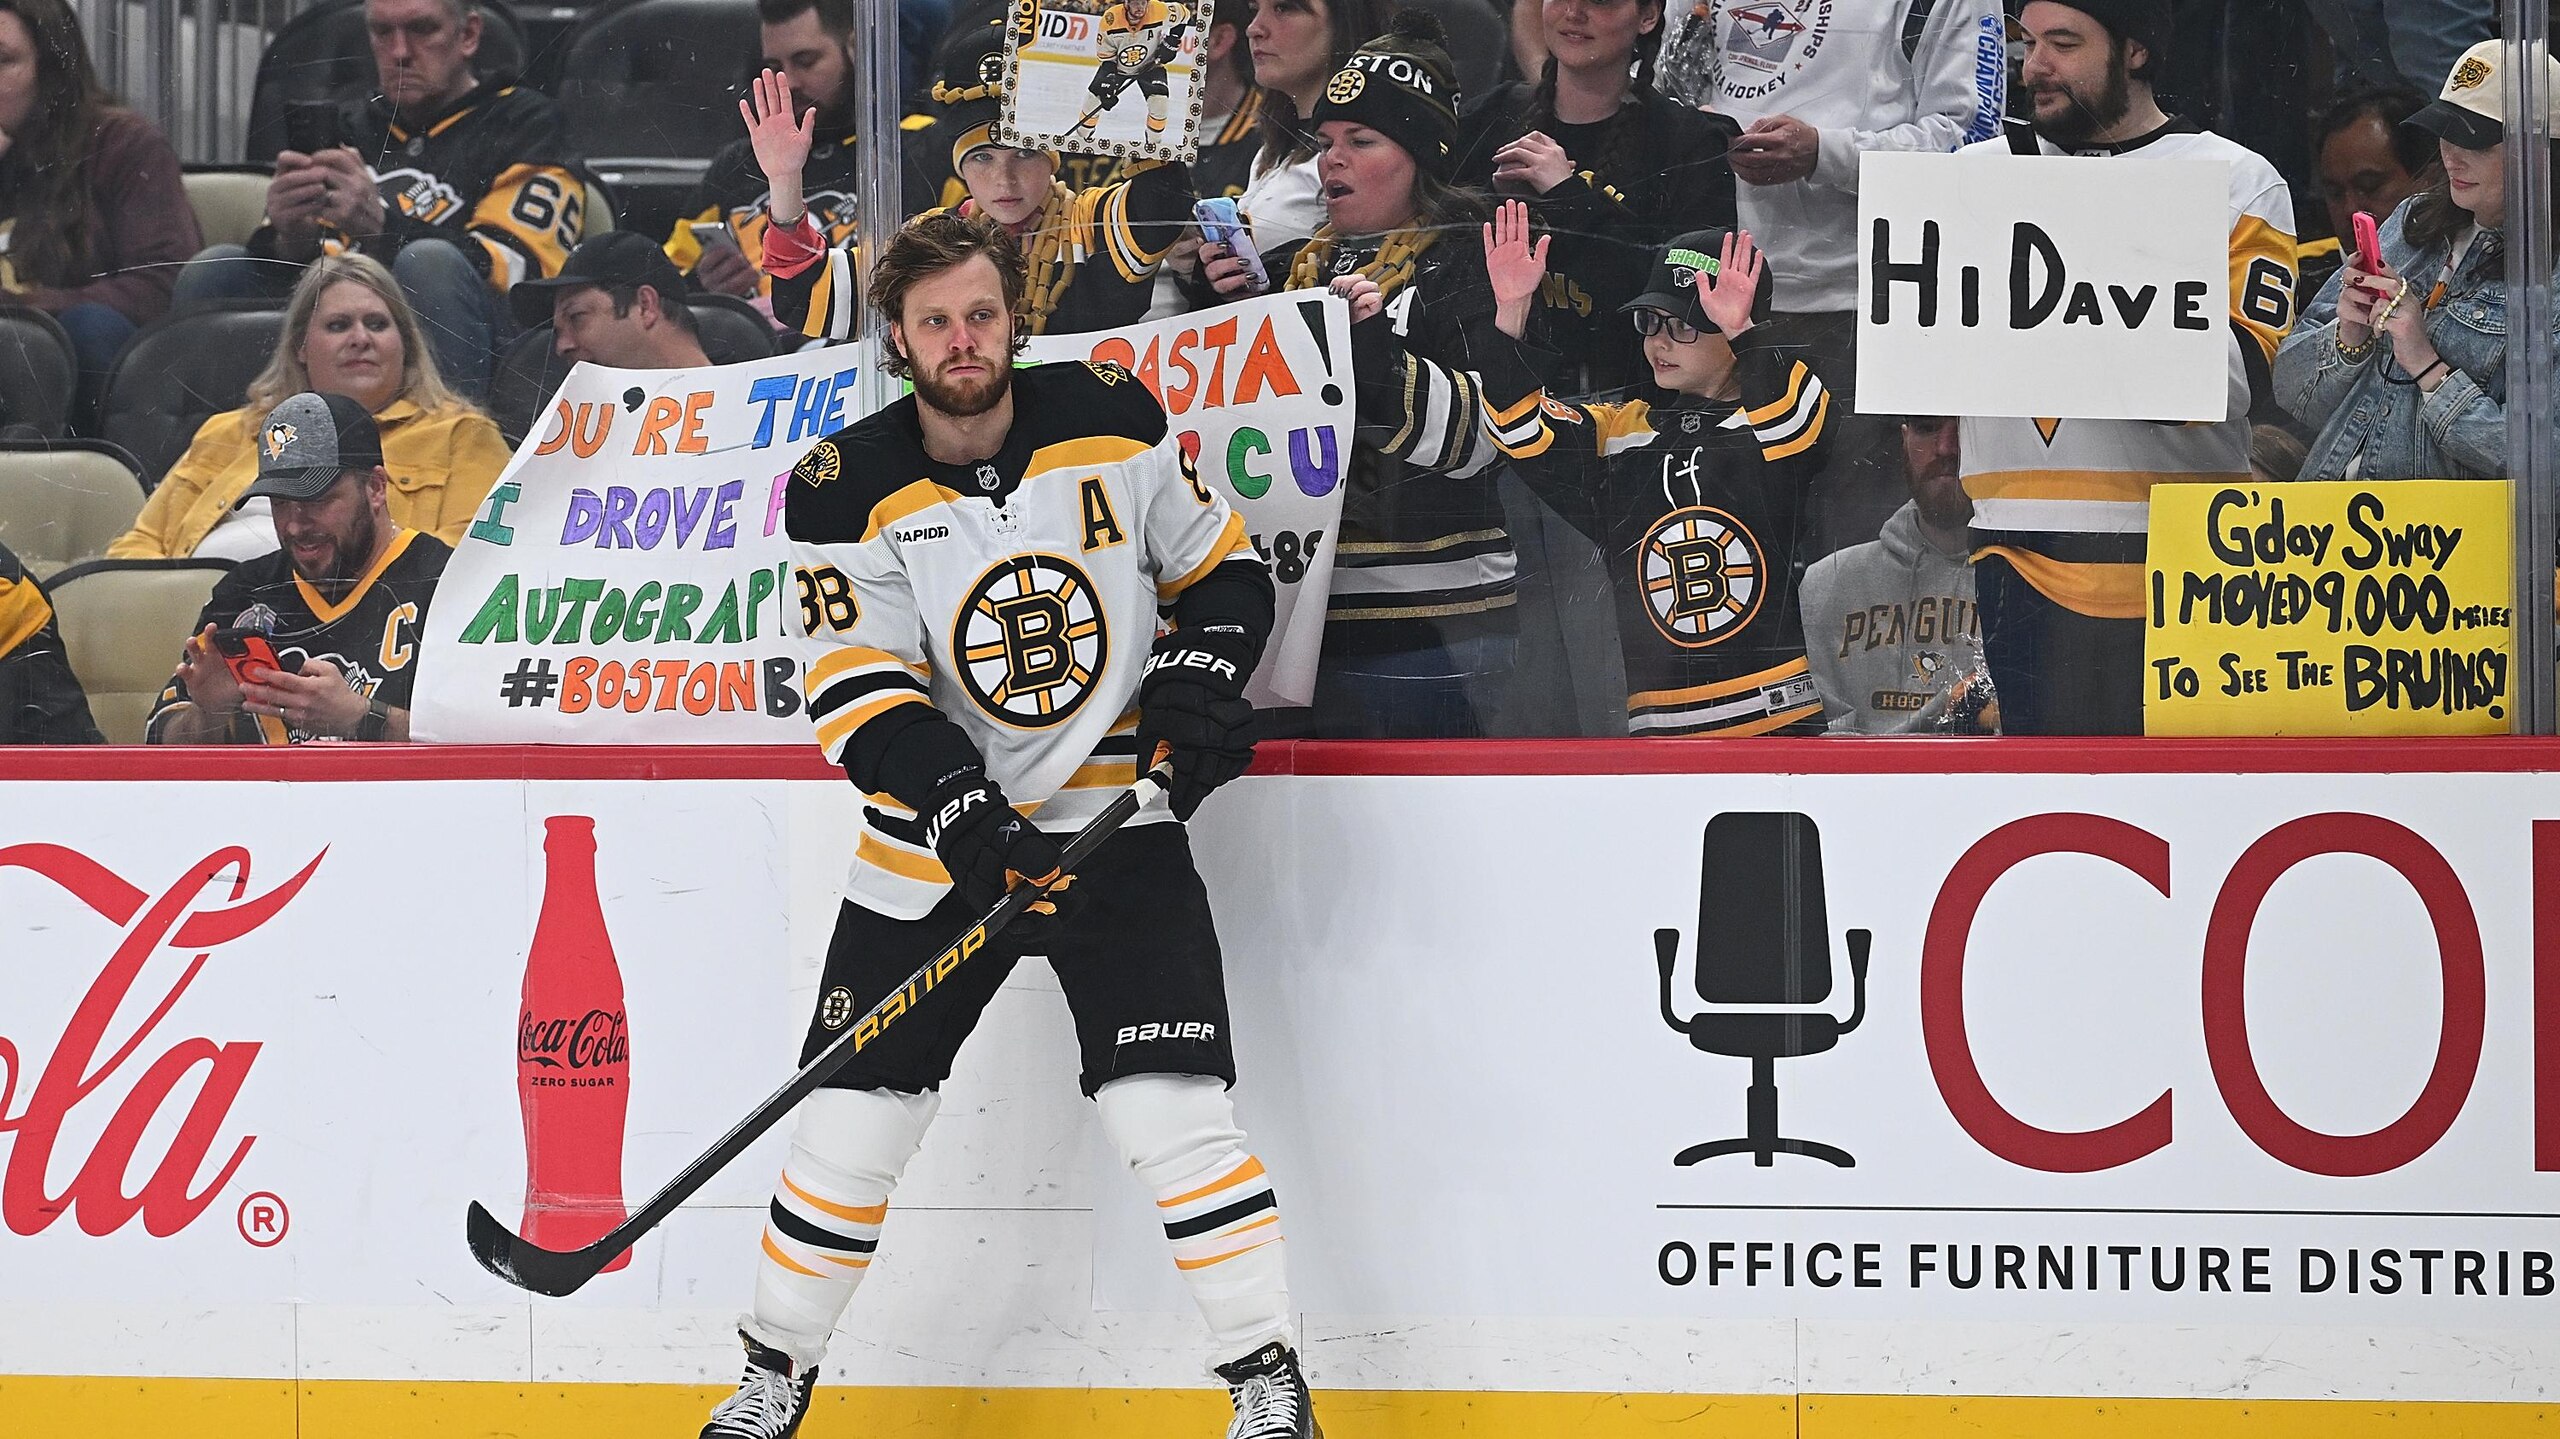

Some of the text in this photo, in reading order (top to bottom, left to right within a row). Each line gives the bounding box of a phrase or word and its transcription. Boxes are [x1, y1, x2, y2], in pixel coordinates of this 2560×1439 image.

[1803, 0, 1832, 58] SHIPS
[1344, 55, 1432, 94] STON
[1724, 71, 1786, 99] HOCKEY
[2009, 221, 2210, 331] DAVE
[533, 385, 714, 459] OU'RE
[747, 366, 858, 450] THE
[469, 481, 521, 547] I
[560, 479, 745, 551] DROVE
[1078, 475, 1127, 555] A
[2207, 488, 2463, 572] G'day Sway
[2152, 569, 2165, 628] I
[2179, 569, 2312, 630] MOVED
[378, 601, 419, 672] C
[1140, 648, 1238, 682] AUER
[500, 656, 811, 718] #BOSTONB
[1881, 694, 1936, 709] HOC
[2152, 644, 2508, 720] TO SEE THE BRUINS!
[925, 788, 989, 851] UER
[1115, 1021, 1216, 1045] BAUER
[531, 1076, 615, 1087] ZERO SUGAR
[1658, 1241, 2555, 1296] OFFICE FURNITURE DISTRIB
[1261, 1347, 1279, 1366] 88
